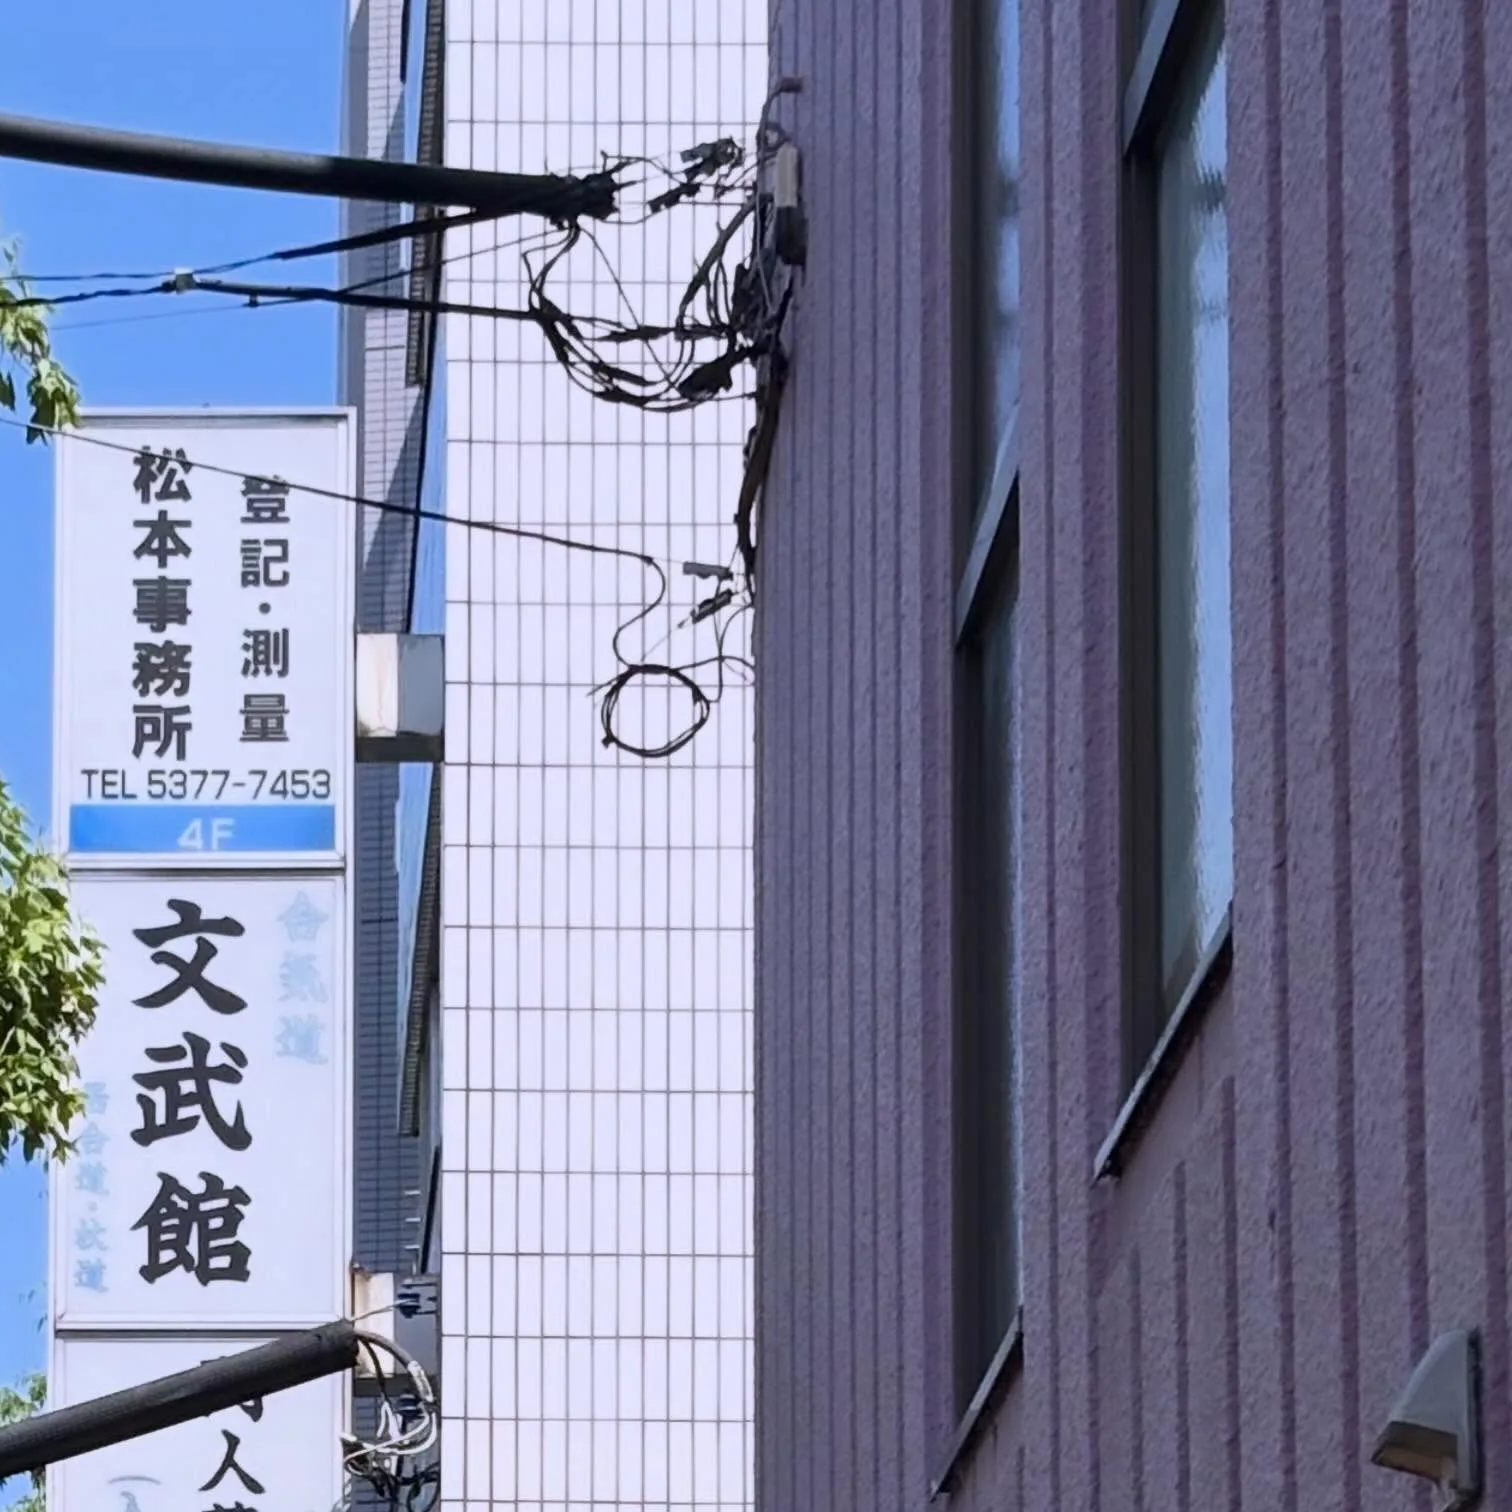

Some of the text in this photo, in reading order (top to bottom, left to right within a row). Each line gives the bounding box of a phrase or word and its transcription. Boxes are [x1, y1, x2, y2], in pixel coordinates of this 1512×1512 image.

[132, 446, 192, 761] 松本事務所
[240, 475, 290, 742] 登記・測量
[81, 769, 331, 799] TEL 5377-7453
[176, 818, 236, 850] 4F
[130, 898, 253, 1286] 文武館
